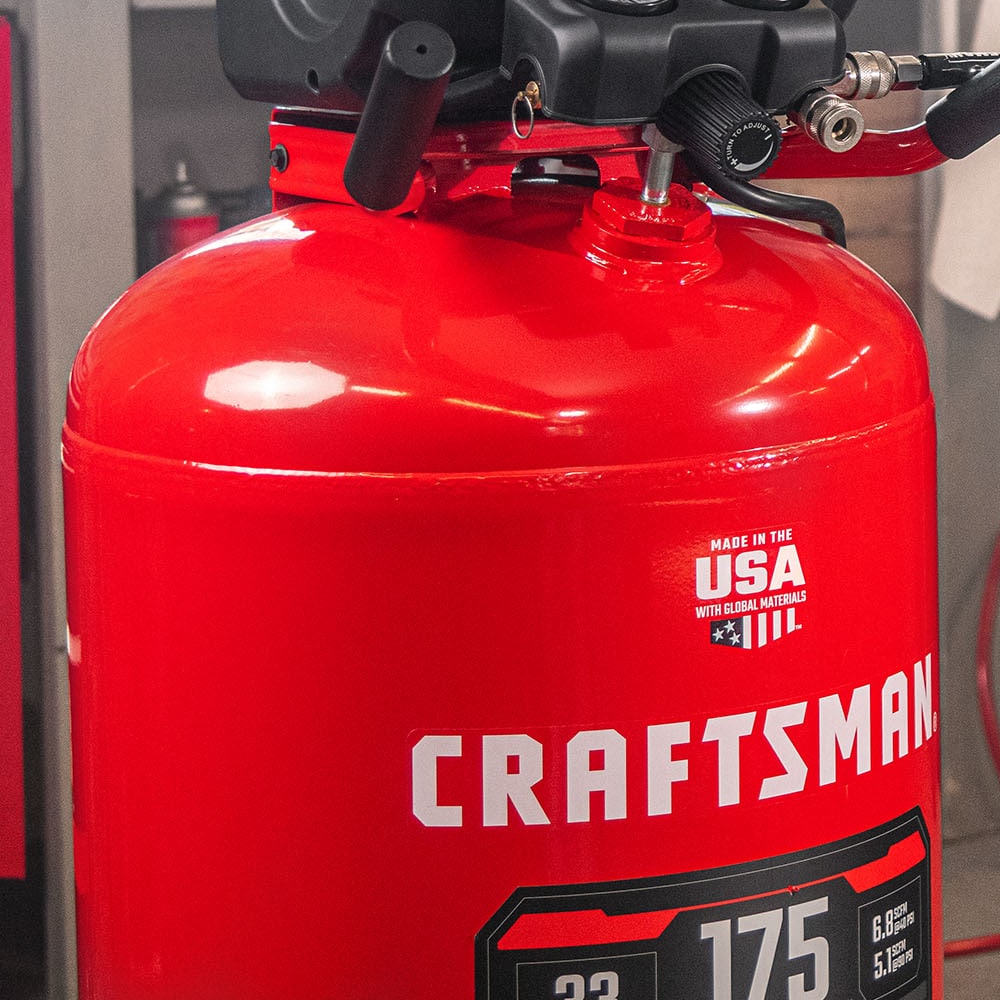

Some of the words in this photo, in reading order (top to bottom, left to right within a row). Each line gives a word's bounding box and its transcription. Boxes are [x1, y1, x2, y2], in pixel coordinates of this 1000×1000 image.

[726, 139, 735, 161] TURN
[732, 128, 742, 138] TO
[743, 122, 771, 134] ADJUST
[711, 535, 749, 551] MADE
[752, 532, 767, 546] IN
[770, 528, 793, 543] THE
[695, 544, 806, 601] USA
[695, 603, 722, 619] WITH
[724, 598, 759, 617] GLOBAL
[760, 589, 807, 610] MATERIALS
[411, 652, 933, 828] CRAFTSMAN
[872, 908, 894, 943] 6.8
[893, 901, 908, 919] SCFM
[906, 911, 915, 927] PSI
[700, 896, 830, 1000] 175
[874, 946, 892, 979] 5.1
[905, 947, 914, 964] PSI
